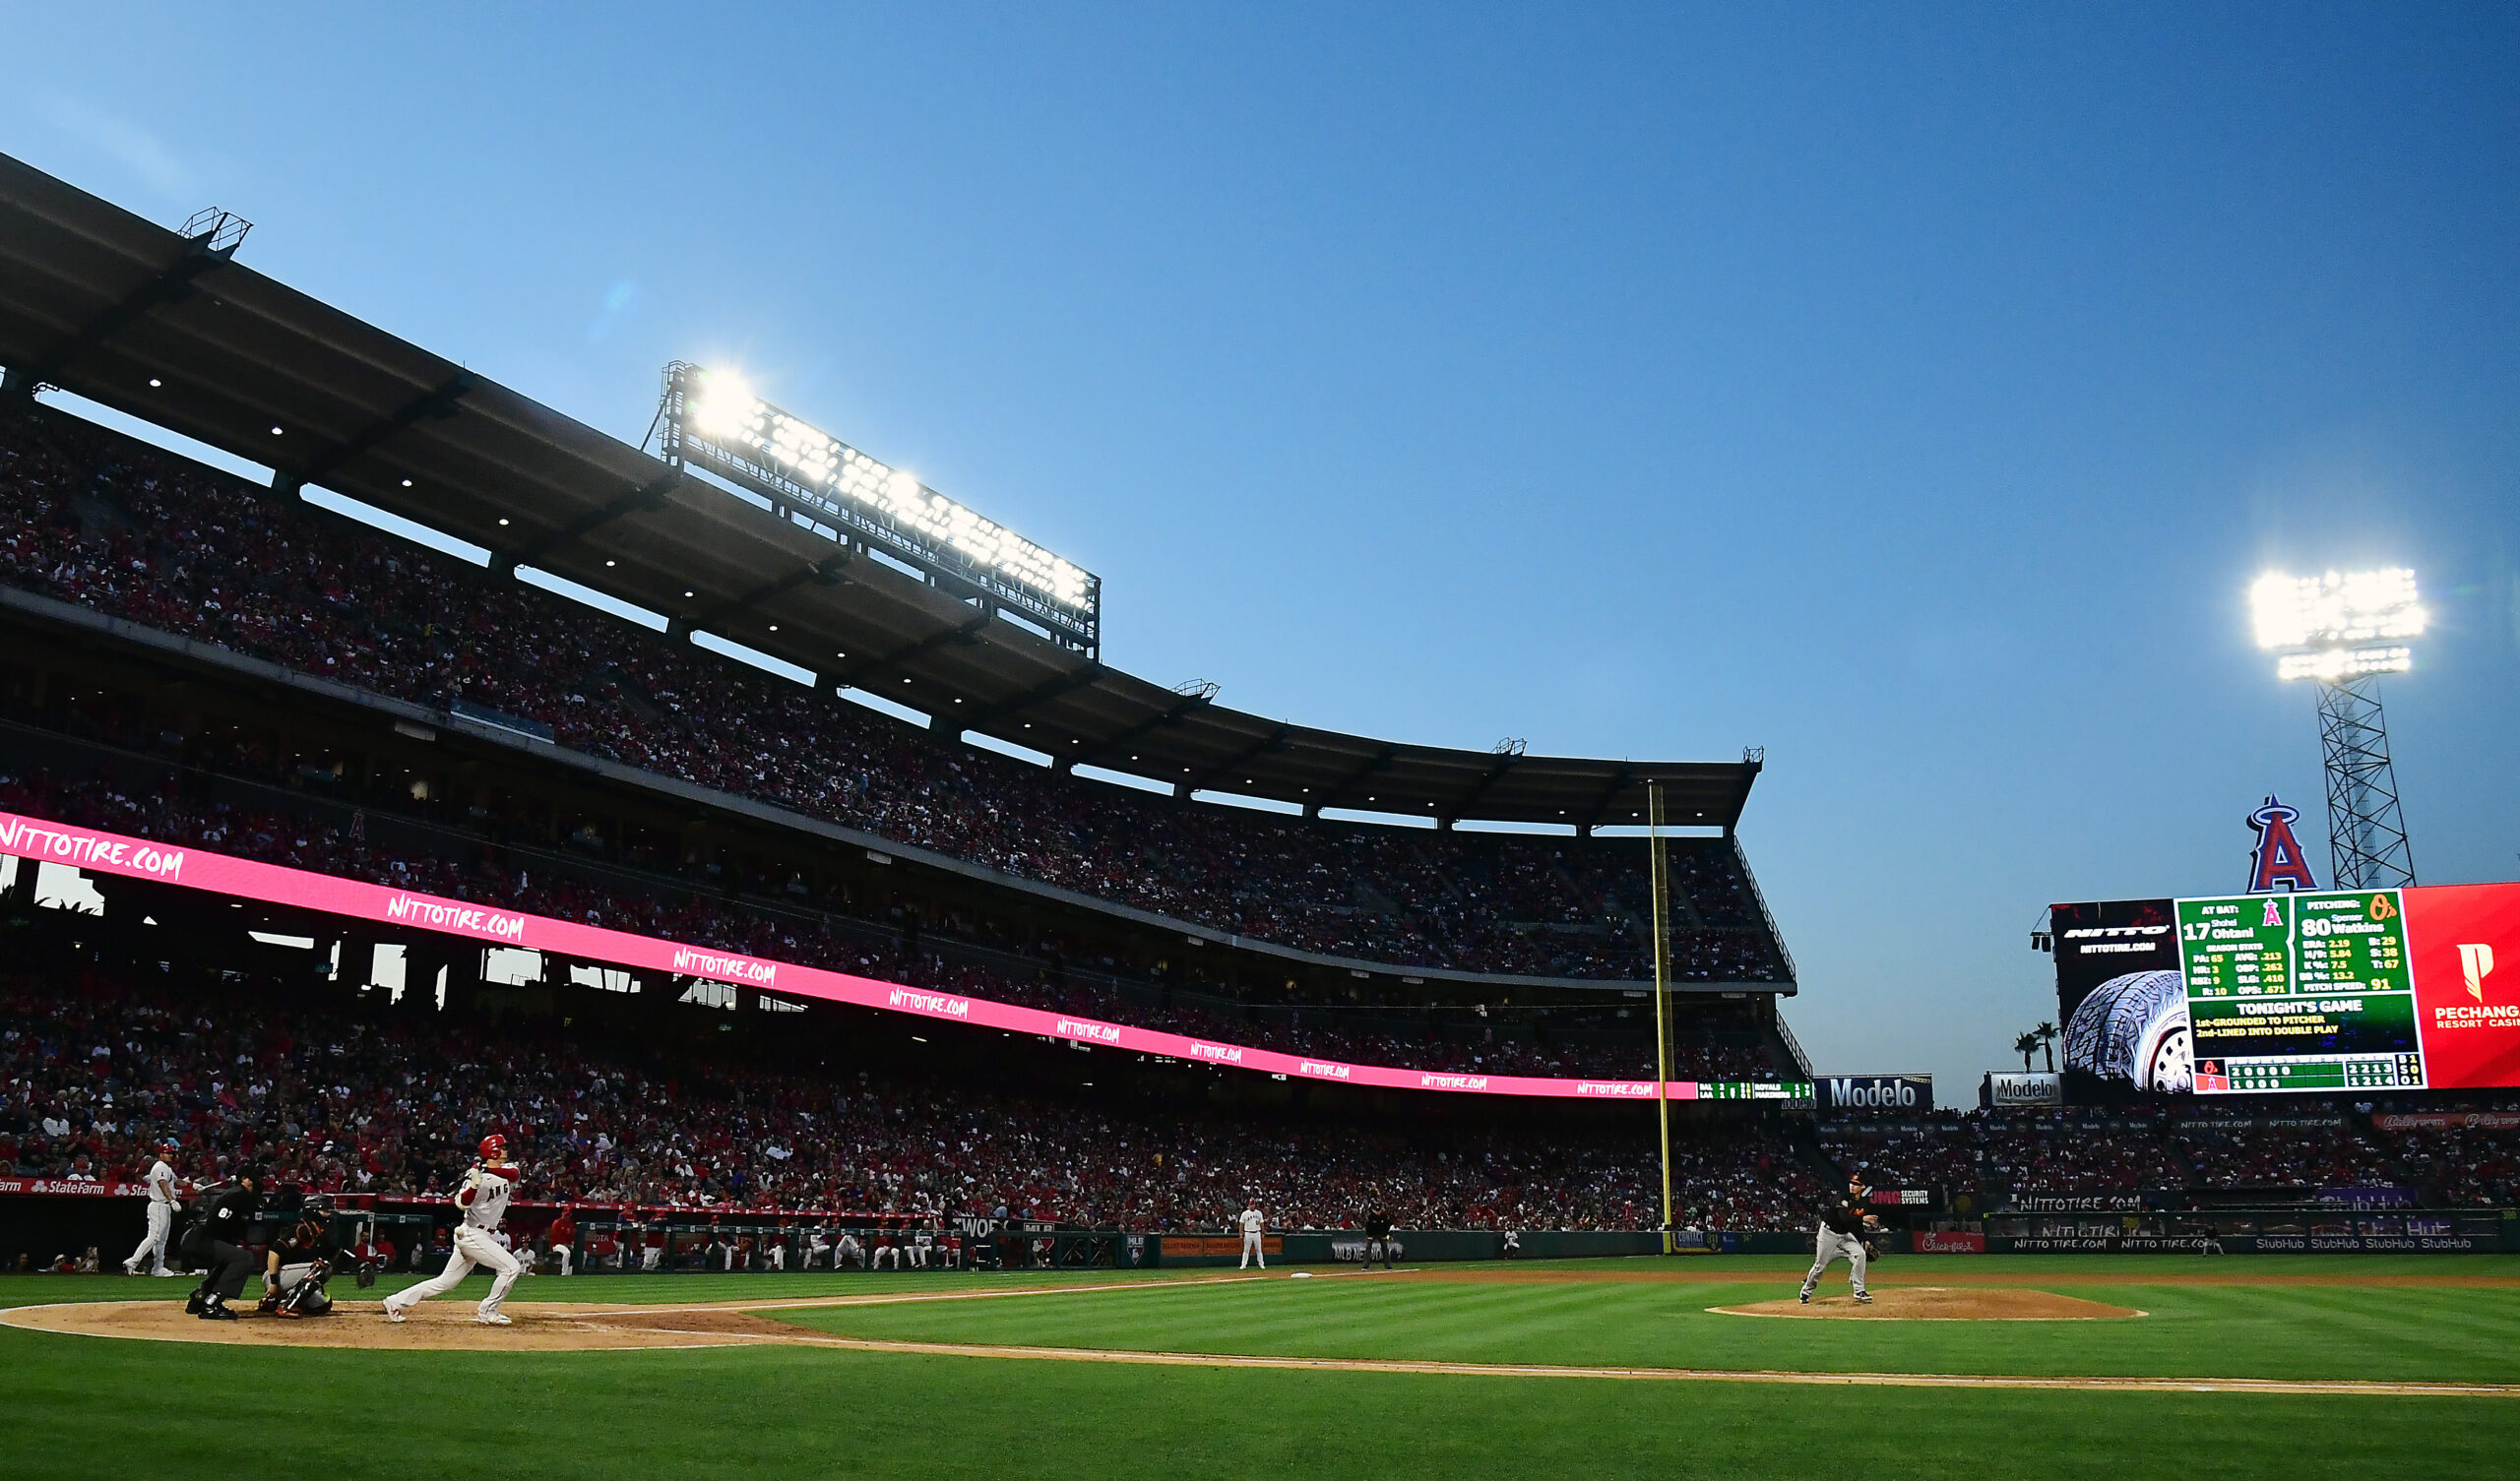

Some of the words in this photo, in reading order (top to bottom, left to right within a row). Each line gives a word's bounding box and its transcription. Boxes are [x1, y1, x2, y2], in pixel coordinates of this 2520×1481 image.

[0, 818, 184, 881] NITTOTIRE.COM
[2216, 905, 2239, 914] BAT:
[2306, 899, 2362, 910] PITCHING:
[387, 893, 525, 943] NITTOTIRE.COM
[2211, 918, 2237, 927] Shohei
[2331, 914, 2364, 923] Spenser
[2064, 926, 2167, 939] NITTO
[2182, 922, 2211, 941] 17
[2211, 927, 2254, 939] Ohtani
[2301, 918, 2331, 937] 80
[2331, 922, 2385, 934] Watkins
[2302, 940, 2326, 949] ERA:
[2328, 939, 2351, 948] 2.19
[2381, 936, 2397, 946] 29
[2080, 943, 2156, 955] NITTOTIRE.COM
[2206, 944, 2237, 953] SEASON
[2238, 943, 2264, 952] STATS
[2369, 948, 2382, 957] S:
[2382, 948, 2399, 957] 38
[2193, 955, 2210, 963] PA:
[2235, 953, 2258, 961] AVG:
[2261, 952, 2283, 961] .213
[2329, 950, 2353, 958] 5.84
[673, 946, 777, 987] NITTOTIRE.COM
[2192, 965, 2211, 974] HR:
[2262, 963, 2284, 972] .262
[2331, 960, 2348, 969] 7.5
[2371, 959, 2384, 968] T:
[2384, 959, 2399, 969] 67
[2213, 976, 2221, 985] 9
[2236, 975, 2260, 984] SLG:
[2263, 974, 2285, 983] .410
[2332, 971, 2355, 980] 13.2
[2237, 986, 2262, 995] OPS:
[2264, 985, 2286, 994] .671
[2303, 982, 2333, 992] PITCH
[2333, 981, 2366, 990] SPEED:
[2370, 978, 2391, 990] 91
[2202, 987, 2214, 996] R:
[2215, 987, 2228, 996] 10
[889, 986, 969, 1019] NITTOTIRE.COM
[2236, 1001, 2318, 1016] TONIGHT'S
[2319, 1000, 2363, 1013] GAME
[2434, 1006, 2520, 1019] PECHANG
[2195, 1018, 2266, 1027] 1st-GROUNDED
[2267, 1017, 2280, 1025] TO
[2283, 1015, 2326, 1024] PITCHER
[2436, 1019, 2483, 1029] RESORT
[1056, 1016, 1120, 1045] NITTOTIRE.COM
[2196, 1028, 2246, 1037] 2nd-LINED
[2248, 1026, 2273, 1036] INTO
[2274, 1025, 2313, 1035] DOUBLE
[2313, 1024, 2339, 1033] PLAY
[2409, 1054, 2418, 1063] 1
[2232, 1067, 2240, 1077] 2
[2244, 1067, 2253, 1077] 0
[2256, 1067, 2266, 1076] 0
[2269, 1066, 2278, 1076] 0
[2282, 1066, 2291, 1076] 0
[2349, 1064, 2358, 1074] 2
[2361, 1064, 2370, 1074] 2
[2372, 1064, 2381, 1073] 1
[2383, 1063, 2392, 1073] 3
[2400, 1065, 2409, 1075] S
[2410, 1065, 2420, 1074] 0
[2233, 1080, 2241, 1089] 1
[2245, 1079, 2254, 1088] 0
[2258, 1079, 2267, 1088] 0
[2270, 1078, 2280, 1087] 0
[2351, 1077, 2360, 1086] 1
[2362, 1077, 2371, 1085] 2
[2374, 1076, 2382, 1085] 1
[2385, 1076, 2394, 1085] 4
[2412, 1076, 2421, 1084] 1
[1830, 1078, 1917, 1108] Modelo
[2000, 1079, 2051, 1098] Modelo
[1901, 1197, 1930, 1205] SYSTEMS
[2014, 1238, 2049, 1249] NITTO
[2052, 1238, 2107, 1249] TIRE.COM
[2120, 1238, 2158, 1249] NITTO
[2161, 1238, 2206, 1249] TIRE.CO
[2255, 1238, 2305, 1250] StubHub
[2312, 1238, 2361, 1250] StubHub
[2364, 1238, 2416, 1250] StubHub
[2420, 1238, 2473, 1250] StubHub
